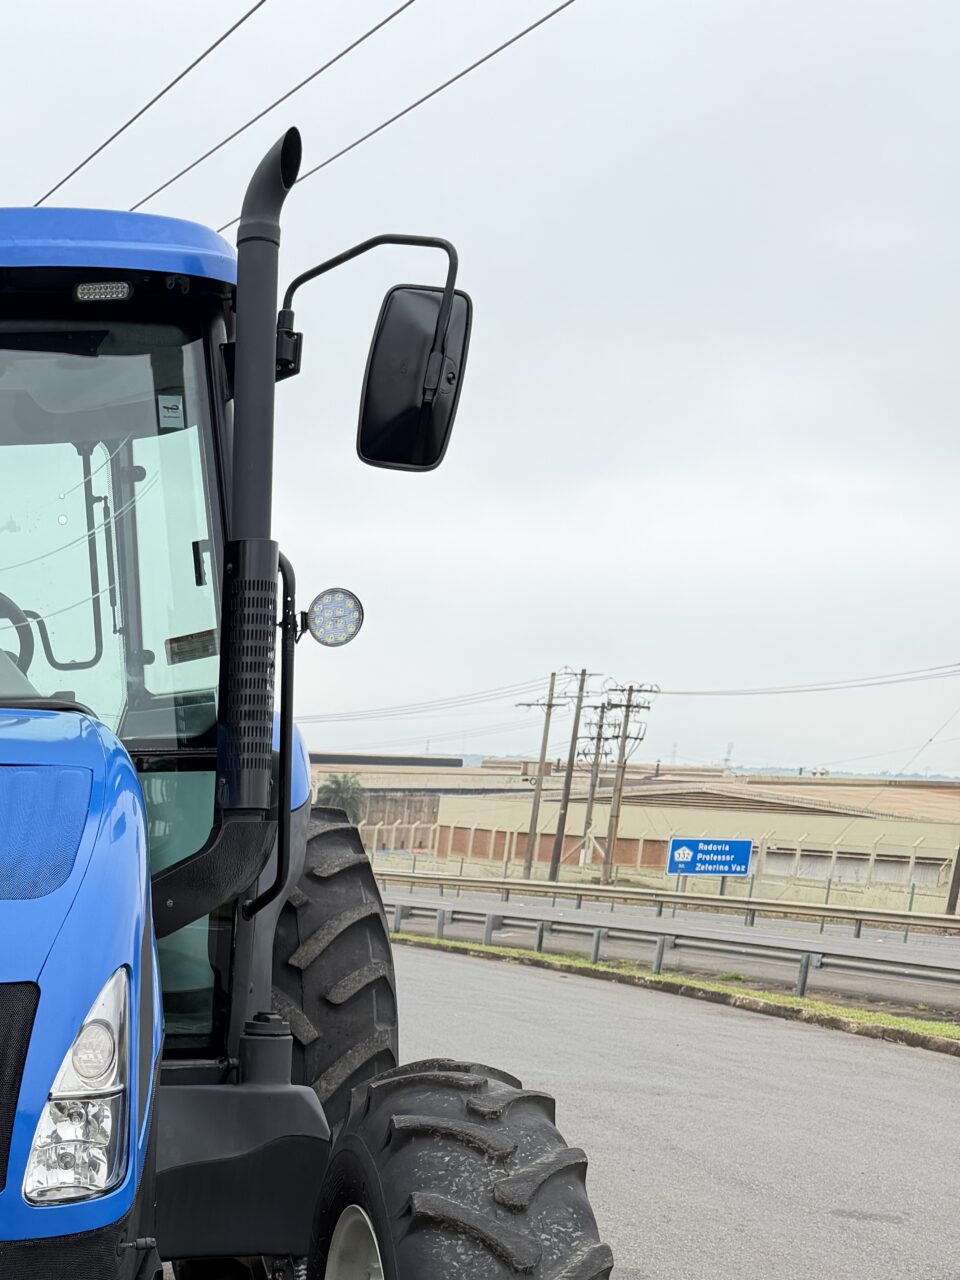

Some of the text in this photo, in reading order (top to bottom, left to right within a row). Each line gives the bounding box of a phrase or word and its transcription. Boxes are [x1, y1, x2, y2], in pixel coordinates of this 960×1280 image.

[698, 842, 730, 851] Rodovia
[696, 852, 735, 861] Professor
[695, 863, 729, 872] Zeferino
[731, 863, 746, 872] Vaz
